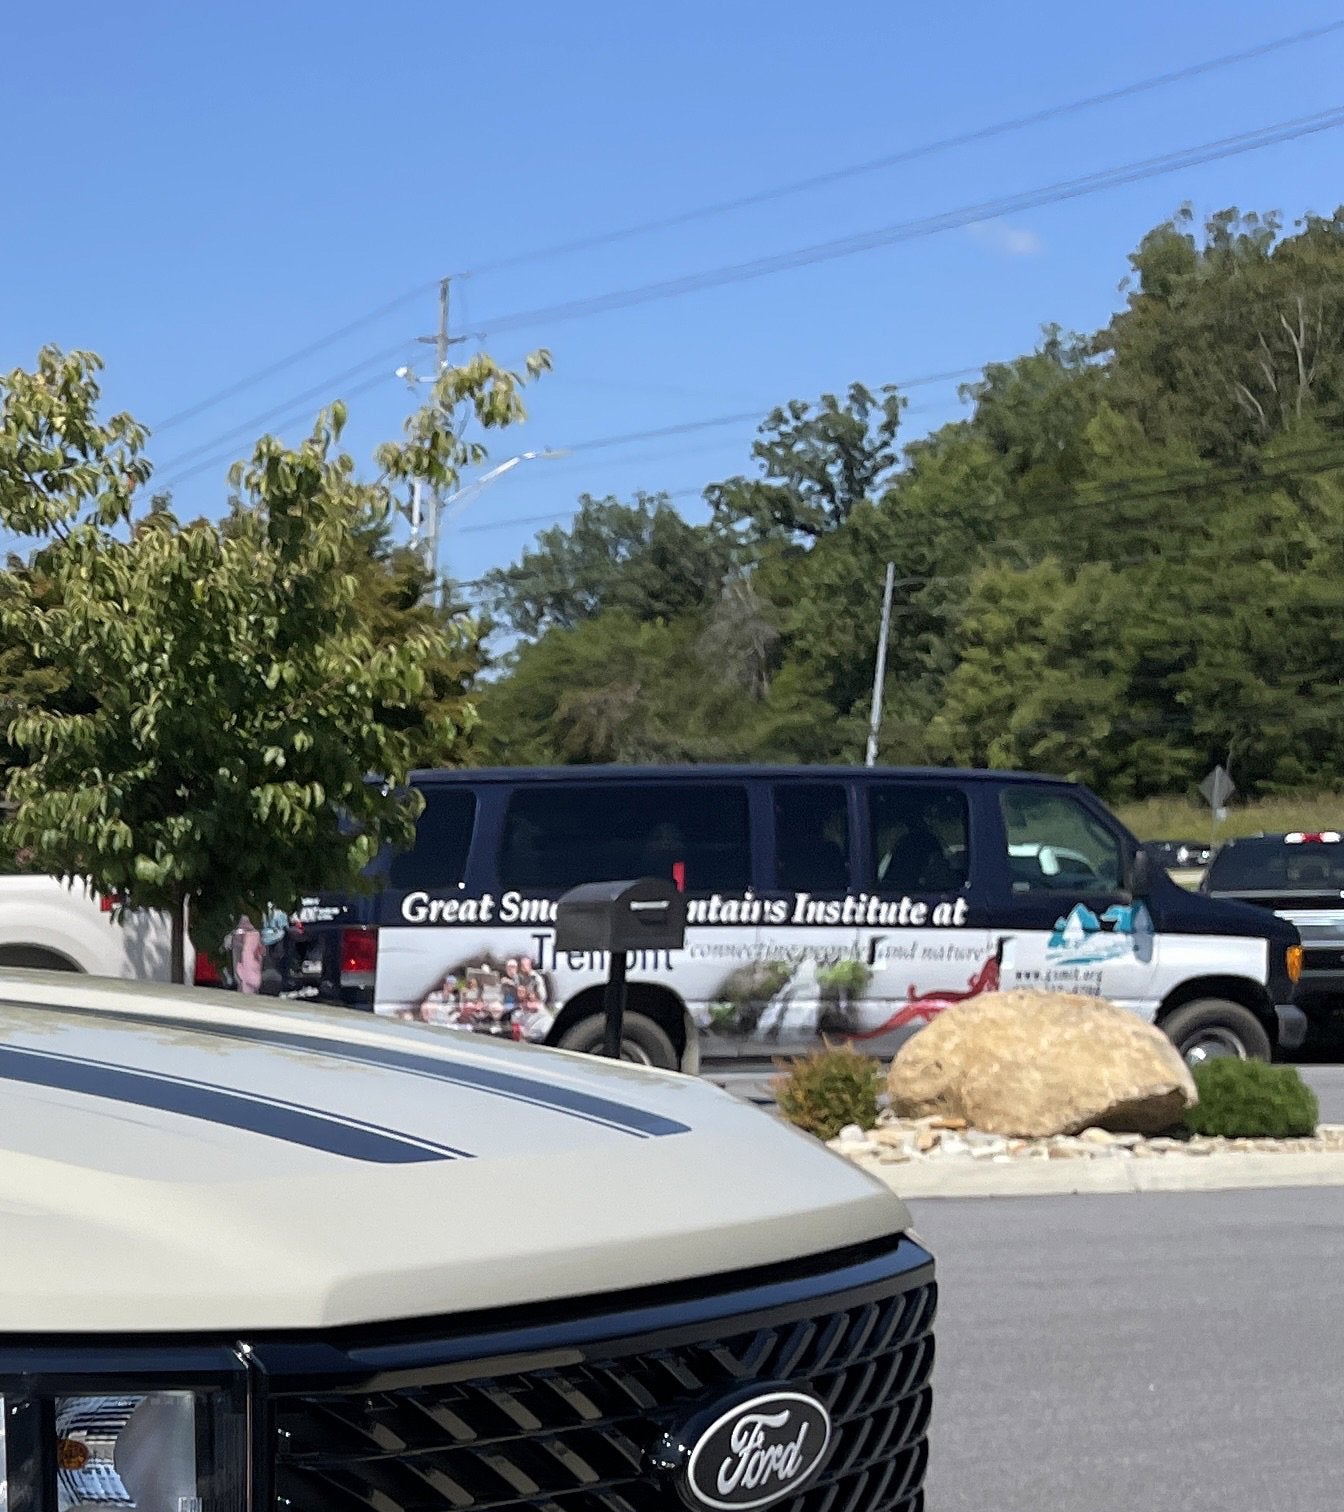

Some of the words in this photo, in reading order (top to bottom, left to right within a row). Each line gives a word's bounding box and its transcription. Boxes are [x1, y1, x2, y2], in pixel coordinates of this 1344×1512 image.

[401, 891, 494, 923] Great
[499, 891, 559, 923] Smo
[686, 891, 790, 924] ntains
[791, 892, 928, 926] Institute
[932, 897, 969, 926] at
[717, 1409, 809, 1495] Ford
